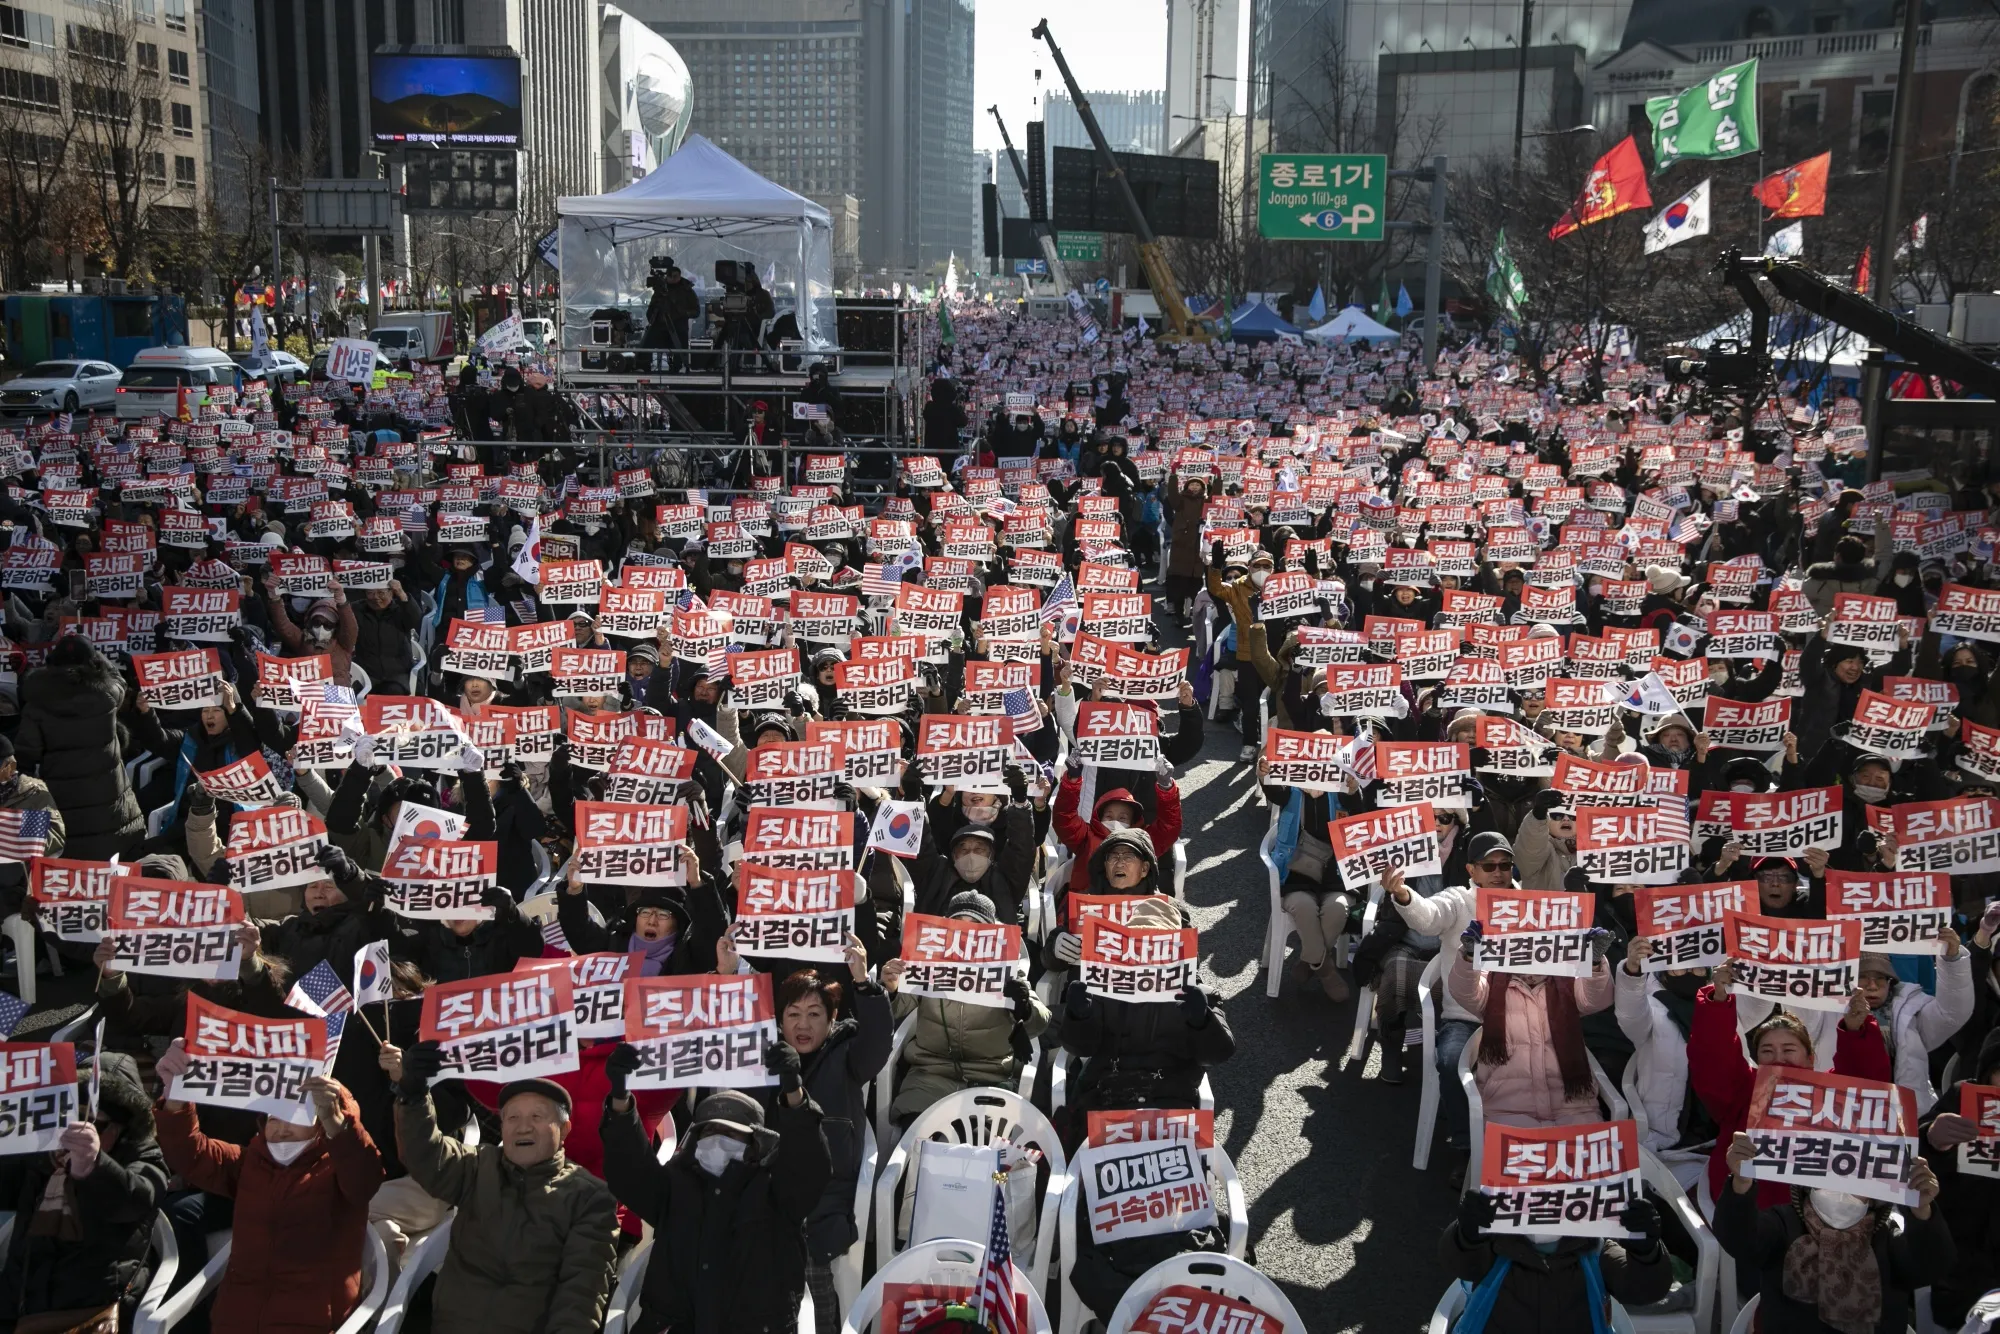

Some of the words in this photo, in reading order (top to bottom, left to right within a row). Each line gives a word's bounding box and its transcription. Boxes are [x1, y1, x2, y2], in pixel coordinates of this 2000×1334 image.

[1270, 162, 1373, 189] 종로1가
[1268, 191, 1308, 209] Jongno
[1312, 191, 1348, 209] 1(il)-ga
[1324, 213, 1335, 228] 6
[357, 459, 391, 470] 주사파
[811, 457, 841, 469] 주사파
[807, 470, 843, 483] 척결하라
[1083, 500, 1115, 513] 주사파
[710, 539, 756, 557] 척결하라
[951, 528, 988, 544] 주사파
[947, 545, 991, 558] 척결하라
[1488, 547, 1535, 565] 척결하라
[89, 558, 136, 577] 주사파
[338, 569, 392, 588] 척결하라
[547, 566, 596, 585] 주사파
[629, 569, 678, 589] 주사파
[745, 561, 788, 584] 주사파
[1084, 570, 1134, 587] 주사파
[545, 582, 602, 600] 척결하라
[741, 577, 790, 598] 척결하라
[1264, 577, 1311, 601] 주사파
[1528, 587, 1573, 610] 주사파
[170, 593, 229, 613] 주사파
[607, 594, 657, 615] 주사파
[798, 597, 848, 617] 주사파
[905, 588, 957, 613] 주사파
[987, 597, 1036, 618] 주사파
[1093, 598, 1143, 617] 주사파
[1262, 590, 1314, 615] 척결하라
[1450, 592, 1498, 611] 주사파
[1843, 600, 1897, 622] 주사파
[166, 615, 236, 634] 척결하라
[600, 613, 660, 634] 척결하라
[899, 611, 958, 635] 척결하라
[982, 614, 1040, 637] 척결하라
[1446, 609, 1500, 628] 척결하라
[1521, 604, 1575, 623] 척결하라
[455, 626, 511, 650] 주사파
[517, 624, 567, 650] 주사파
[792, 619, 857, 641] 척결하라
[1716, 620, 1774, 641] 주사파
[1832, 622, 1897, 646] 척결하라
[1299, 645, 1362, 665] 척결하라
[1401, 635, 1453, 656] 주사파
[1507, 639, 1561, 667] 주사파
[1573, 642, 1621, 661] 주사파
[1709, 640, 1777, 661] 척결하라
[144, 652, 210, 681] 주사파
[444, 652, 511, 675] 척결하라
[560, 654, 619, 678] 주사파
[736, 655, 797, 682] 주사파
[846, 663, 910, 688] 주사파
[1115, 654, 1180, 681] 주사파
[1398, 655, 1459, 678] 척결하라
[1568, 659, 1618, 678] 척결하라
[556, 681, 622, 697] 척결하라
[1107, 674, 1180, 701] 척결하라
[1336, 669, 1394, 692] 주사파
[1449, 666, 1504, 688] 주사파
[1504, 665, 1565, 689] 척결하라
[144, 678, 219, 706] 척결하라
[1334, 689, 1396, 712] 척결하라
[1441, 687, 1509, 707] 척결하라
[1087, 709, 1152, 738] 주사파
[1549, 705, 1614, 729] 척결하라
[1715, 706, 1783, 728] 주사파
[1864, 700, 1927, 732] 주사파
[925, 719, 1002, 754] 주사파
[1707, 726, 1785, 746] 척결하라
[760, 747, 838, 776] 주사파
[1079, 739, 1157, 762] 척결하라
[1390, 747, 1460, 776] 주사파
[618, 747, 685, 779] 주사파
[921, 749, 1010, 782] 척결하라
[1380, 775, 1467, 804] 척결하라
[1564, 767, 1639, 797] 주사파
[1745, 790, 1829, 829] 주사파
[1907, 799, 1992, 841] 주사파
[230, 812, 312, 856] 주사파
[588, 808, 675, 843] 주사파
[758, 815, 842, 850] 주사파
[1344, 805, 1422, 852] 주사파
[1737, 819, 1838, 854] 척결하라
[395, 844, 483, 877] 주사파
[580, 845, 682, 880] 척결하라
[1345, 836, 1436, 882] 척결하라
[1582, 843, 1686, 879] 척결하라
[747, 872, 842, 914] 주사파
[1841, 874, 1936, 911] 주사파
[124, 888, 231, 927] 주사파
[1490, 896, 1582, 932] 주사파
[736, 914, 853, 951] 척결하라
[917, 923, 1007, 963] 주사파
[1740, 922, 1845, 962] 주사파
[115, 929, 240, 967] 척결하라
[1095, 929, 1183, 962] 주사파
[1480, 932, 1590, 969] 척결하라
[904, 962, 1012, 996] 척결하라
[1086, 963, 1192, 997] 척결하라
[1732, 958, 1854, 1000] 척결하라
[436, 973, 555, 1036] 주사파
[645, 976, 760, 1034] 주사파
[197, 1014, 311, 1057] 주사파
[636, 1026, 770, 1083] 척결하라
[1768, 1083, 1904, 1134] 주사파
[1503, 1126, 1623, 1184] 주사파
[1752, 1133, 1912, 1183] 척결하라
[1101, 1147, 1191, 1193] 이재명
[1094, 1183, 1208, 1233] 구속하라!
